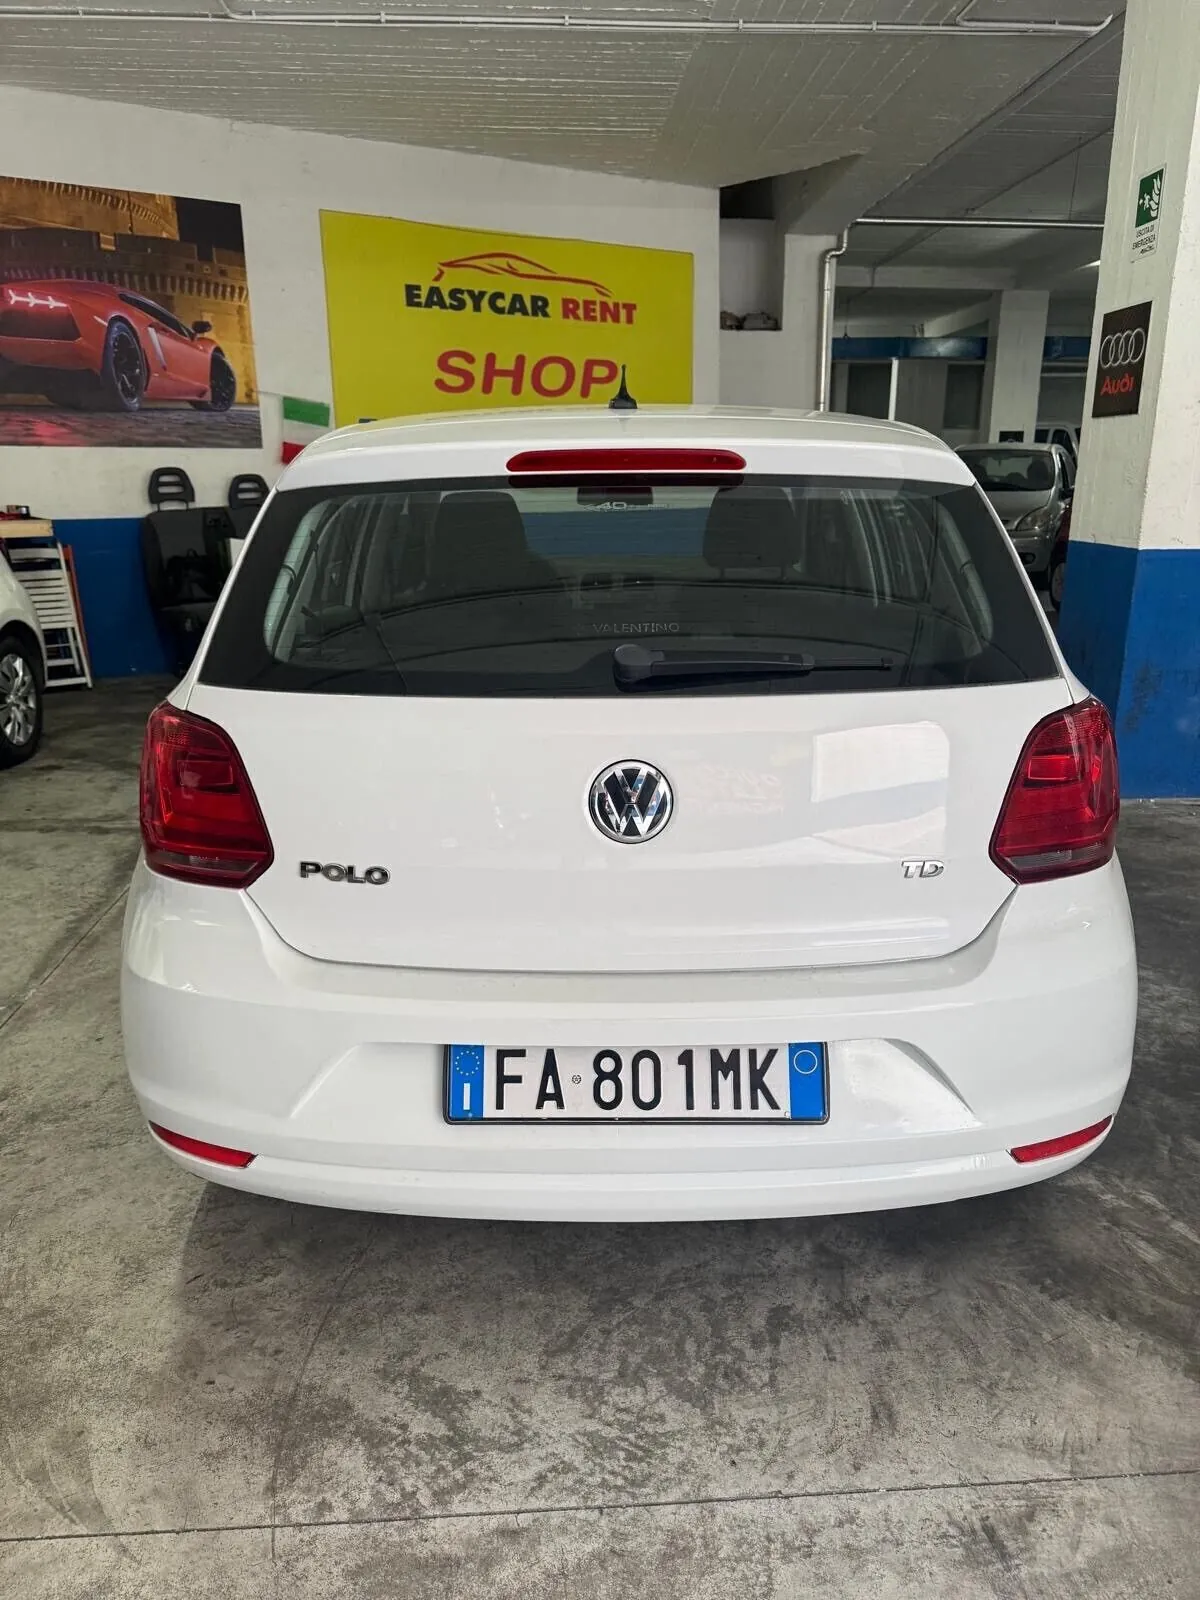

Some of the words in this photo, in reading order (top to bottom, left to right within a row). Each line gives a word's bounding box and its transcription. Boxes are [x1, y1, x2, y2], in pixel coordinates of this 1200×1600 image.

[404, 283, 551, 319] EASYCAR
[561, 298, 637, 325] RENT
[434, 349, 619, 399] SHOP
[1101, 372, 1135, 396] Audi
[592, 622, 680, 633] VALENTINO
[299, 860, 391, 886] POLO
[495, 1048, 566, 1111] FA
[592, 1048, 782, 1111] 801MK
